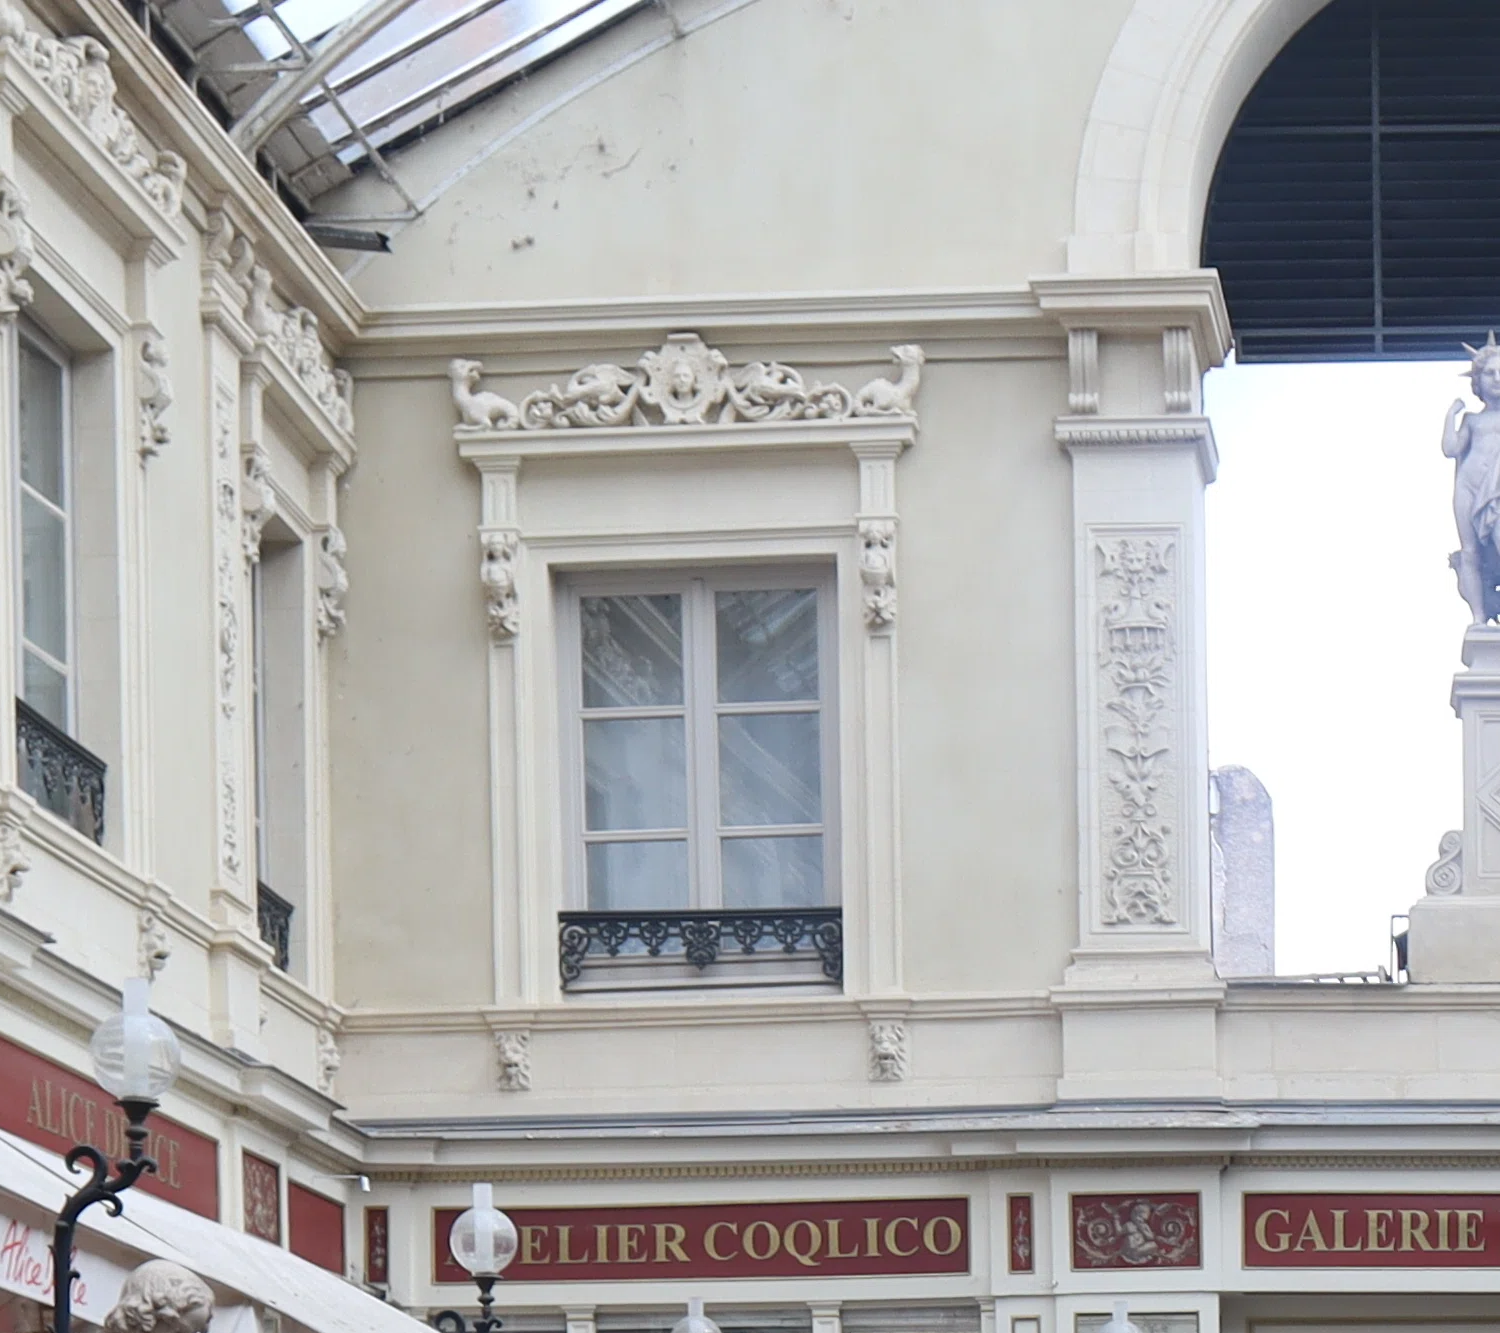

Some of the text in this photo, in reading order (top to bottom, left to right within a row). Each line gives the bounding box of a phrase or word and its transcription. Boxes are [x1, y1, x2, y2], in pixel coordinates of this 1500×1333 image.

[27, 1075, 97, 1150] ALICE
[445, 1214, 963, 1267] ELIER COQLICO
[1254, 1208, 1487, 1252] GALERIE
